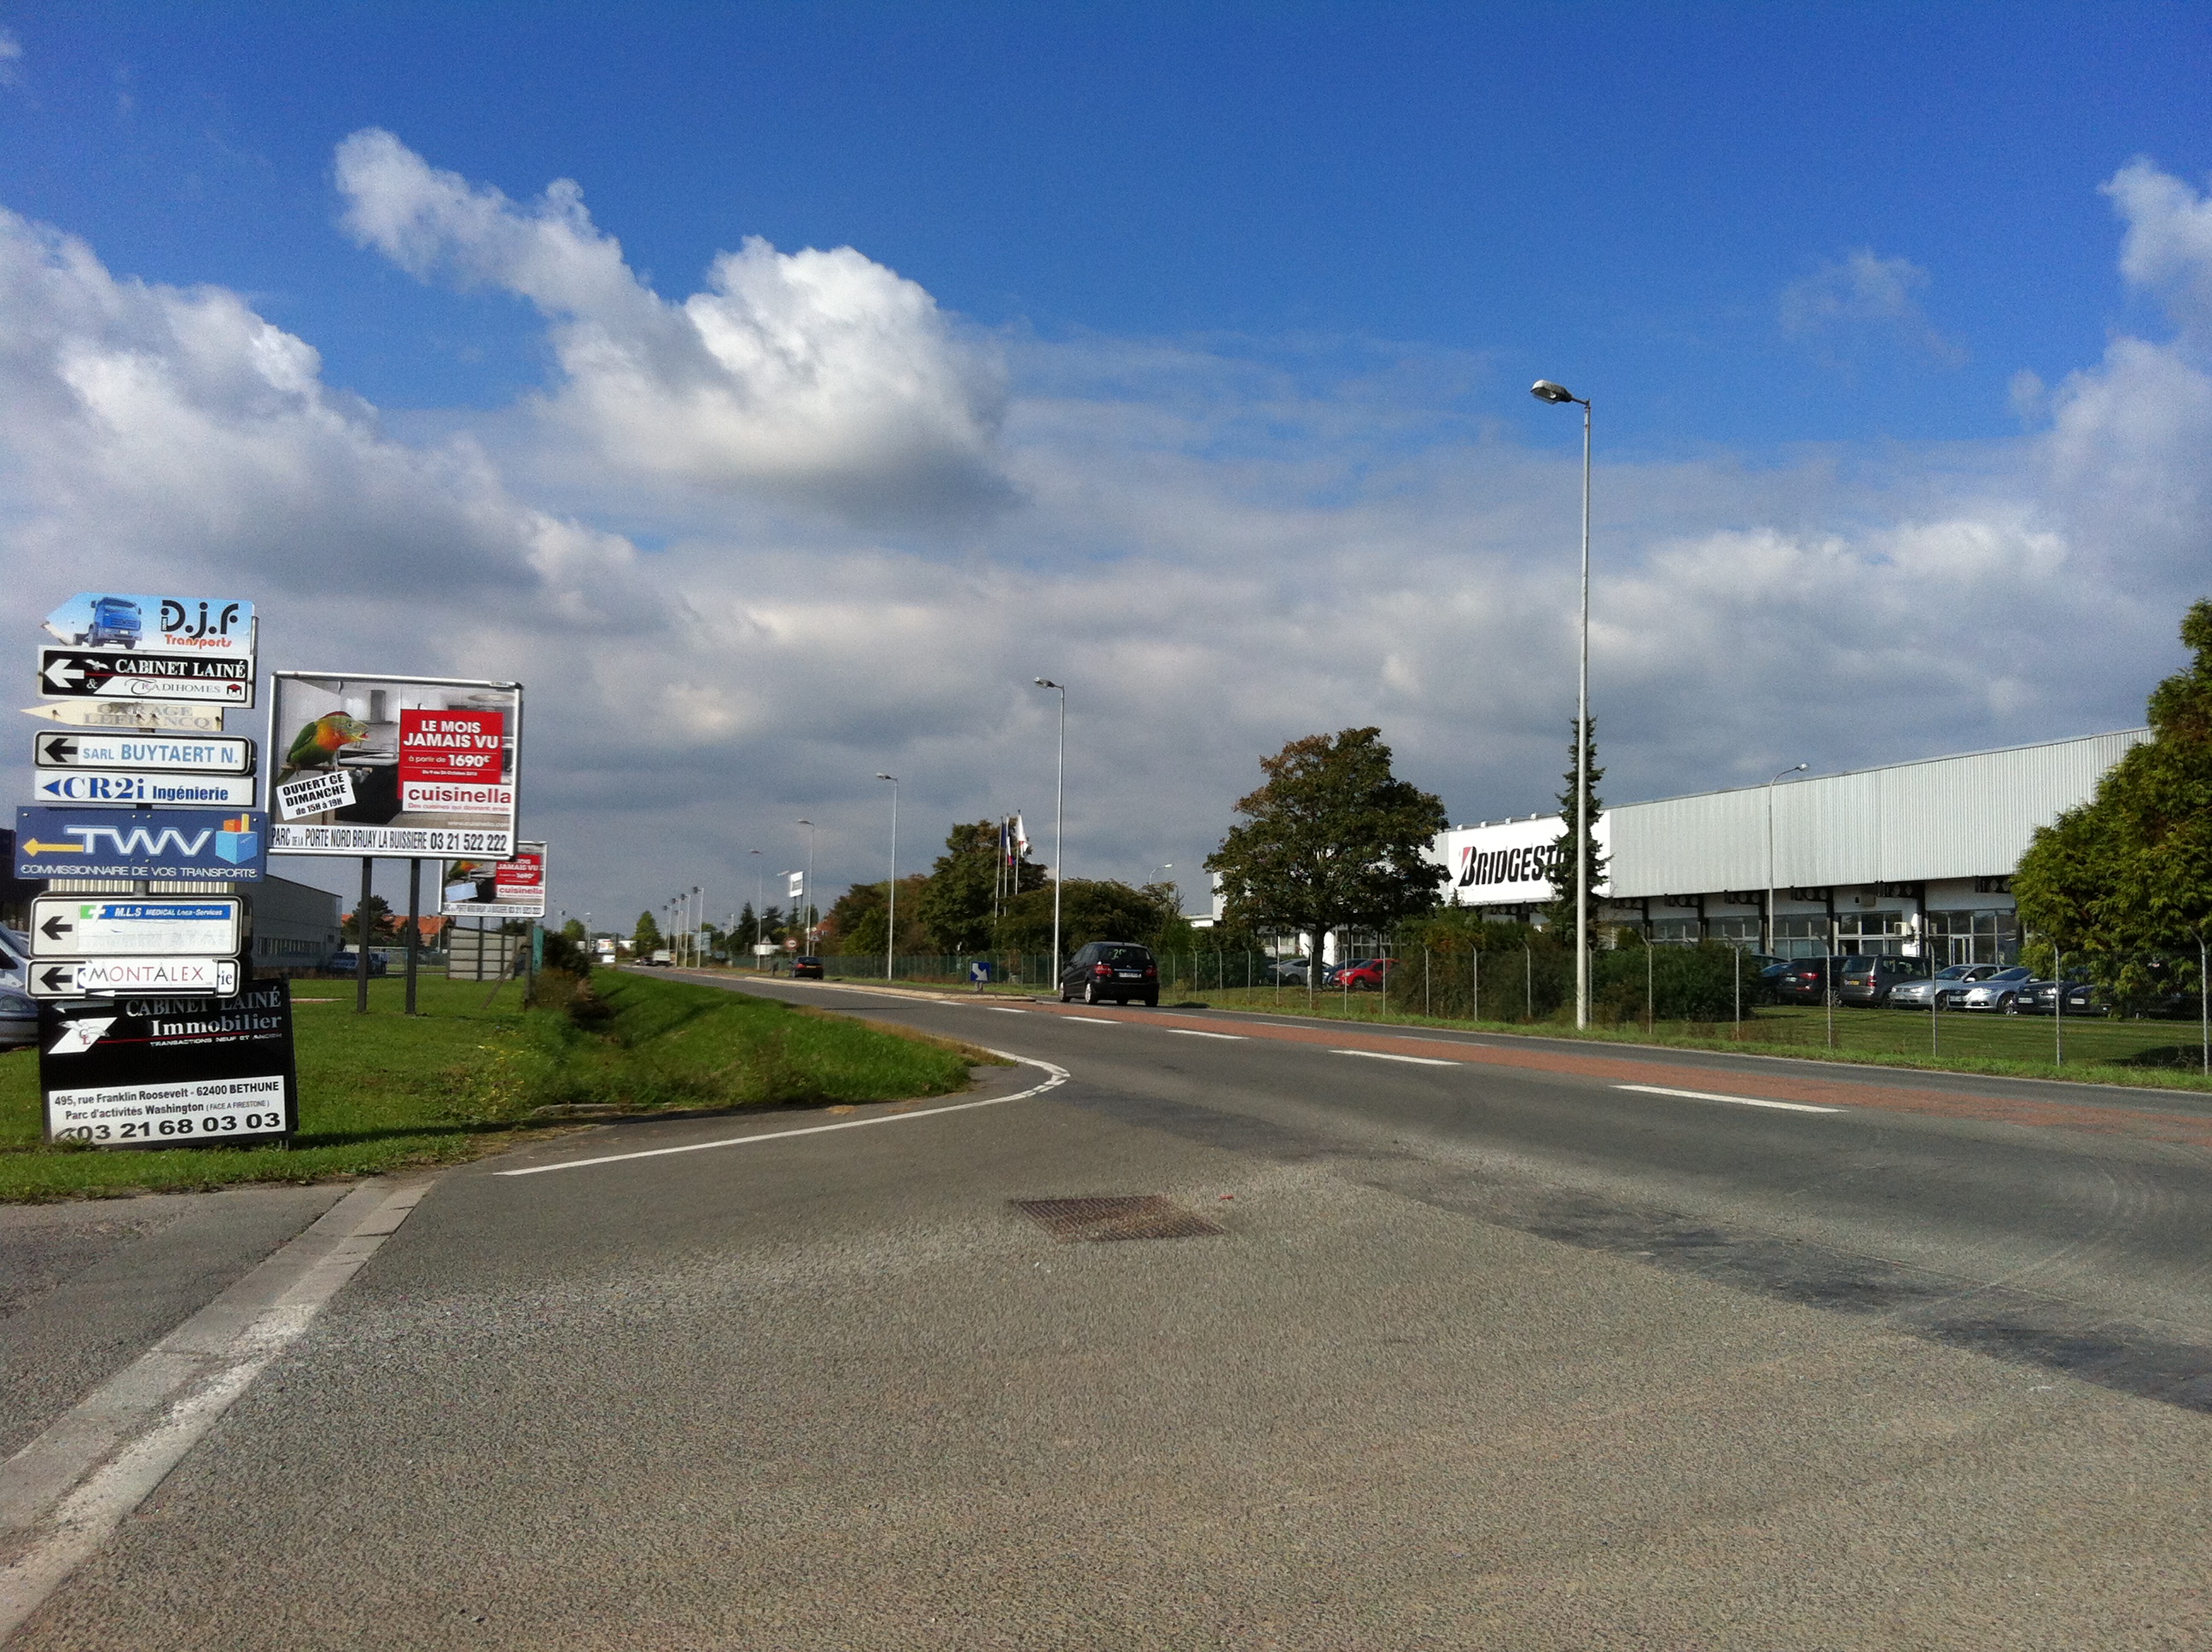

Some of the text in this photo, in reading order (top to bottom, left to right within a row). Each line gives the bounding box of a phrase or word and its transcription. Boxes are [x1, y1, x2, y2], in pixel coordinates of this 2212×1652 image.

[165, 634, 232, 649] Transports
[115, 659, 246, 679] CABINET LAINÉ
[125, 678, 222, 695] TRADIHOMES
[422, 720, 481, 734] LE MOIS
[403, 732, 498, 749] JAMAIS VU
[83, 744, 238, 764] SARL BUYTAERT N.
[63, 777, 229, 801] CR2i Ingénierie
[282, 773, 344, 796] OUVERT CE
[286, 784, 346, 807] DIMANCHE
[408, 786, 511, 804] cuisinella
[295, 806, 306, 816] de
[307, 803, 321, 812] 15H
[271, 827, 290, 846] PARC
[306, 829, 329, 846] PORTE
[331, 829, 351, 847] NORD
[352, 829, 377, 848] BRUAY
[379, 830, 387, 848] LA
[430, 832, 444, 850] 03
[447, 833, 459, 850] 21
[463, 833, 484, 851] 522
[486, 835, 507, 852] 222
[20, 864, 257, 878] COMMISSIONNAIRE DE VOS TRANSPORTS
[1458, 844, 1565, 887] BRIDGEST
[145, 908, 176, 916] MEDICAL
[89, 965, 204, 982] MONTALEX
[125, 998, 208, 1017] CABINET
[151, 1014, 282, 1037] Immobilier
[150, 1038, 212, 1047] TRANSACTIONS
[78, 1096, 95, 1105] rue
[96, 1093, 137, 1102] Franklin
[139, 1088, 189, 1100] Roosevelt
[196, 1085, 227, 1096] 62400
[230, 1081, 279, 1094] BETHUNE
[66, 1110, 89, 1120] Parc
[90, 1106, 143, 1119] d'activités
[145, 1102, 204, 1114] Washington
[77, 1124, 112, 1142] 03
[202, 1115, 237, 1132] 03
[246, 1112, 281, 1129] 03
